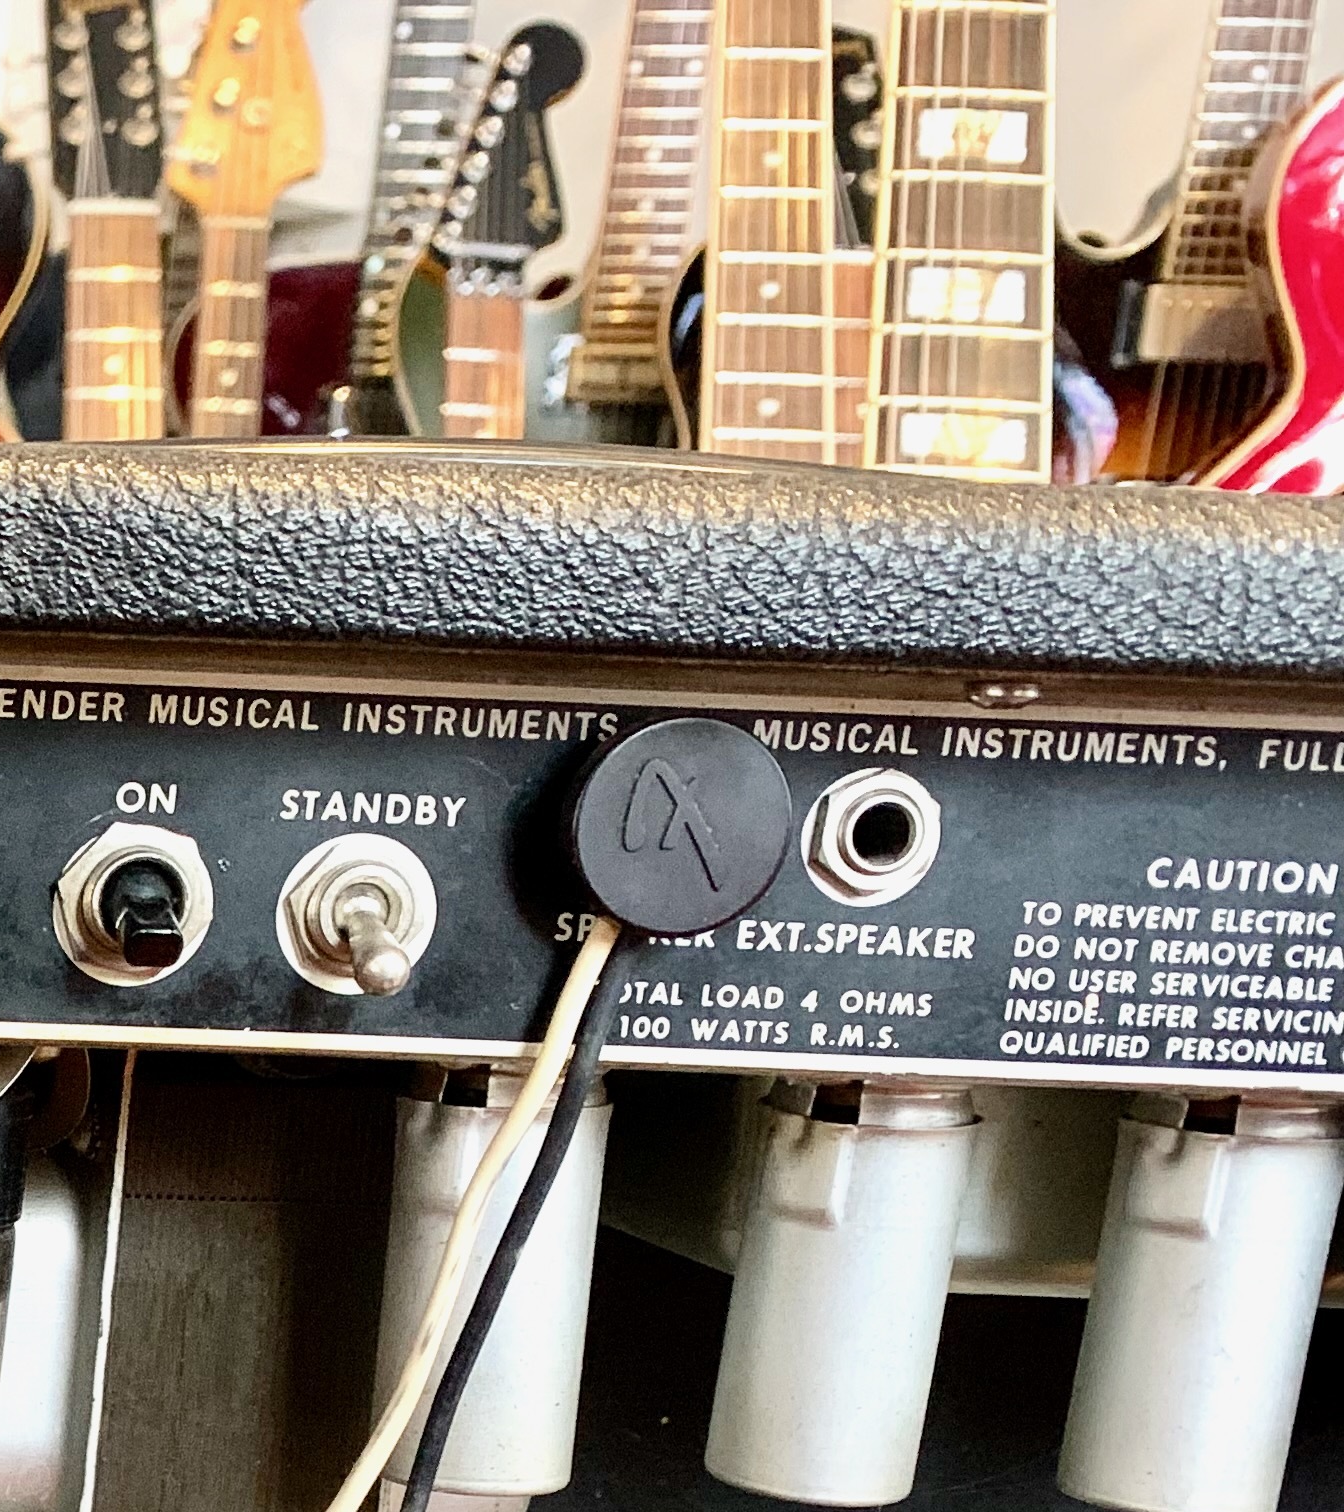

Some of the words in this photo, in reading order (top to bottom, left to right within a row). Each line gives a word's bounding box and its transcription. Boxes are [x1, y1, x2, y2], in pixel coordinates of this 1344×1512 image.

[149, 694, 319, 730] MUSICAL
[343, 703, 618, 741] INSTRUMENTS
[752, 719, 918, 756] MUSICAL
[941, 727, 1226, 771] INSTRUMENTS,
[116, 782, 177, 814] ON
[280, 790, 466, 827] STANDBY
[1147, 857, 1338, 894] CAUTION
[1023, 901, 1061, 925] TO
[1074, 904, 1200, 930] PREVENT
[1211, 909, 1335, 936] ELECTRIC
[1014, 934, 1059, 958] DO
[1074, 937, 1139, 961] NOT
[1150, 940, 1273, 967] REMOVE
[701, 984, 783, 1009] LOAD
[801, 990, 817, 1012] 4
[840, 990, 932, 1016] OHMS
[1009, 967, 1055, 990] NO
[1069, 969, 1137, 993] USER
[1150, 972, 1334, 1002] SERVICEABLE
[1004, 998, 1105, 1025] INSIDE.
[1118, 1003, 1198, 1028] REFER
[621, 1016, 670, 1039] 100
[691, 1019, 789, 1044] WATTS
[811, 1023, 899, 1049] R.M.S.
[1000, 1031, 1149, 1058] QUALIFIED
[1166, 1037, 1327, 1065] PERSONNEL
